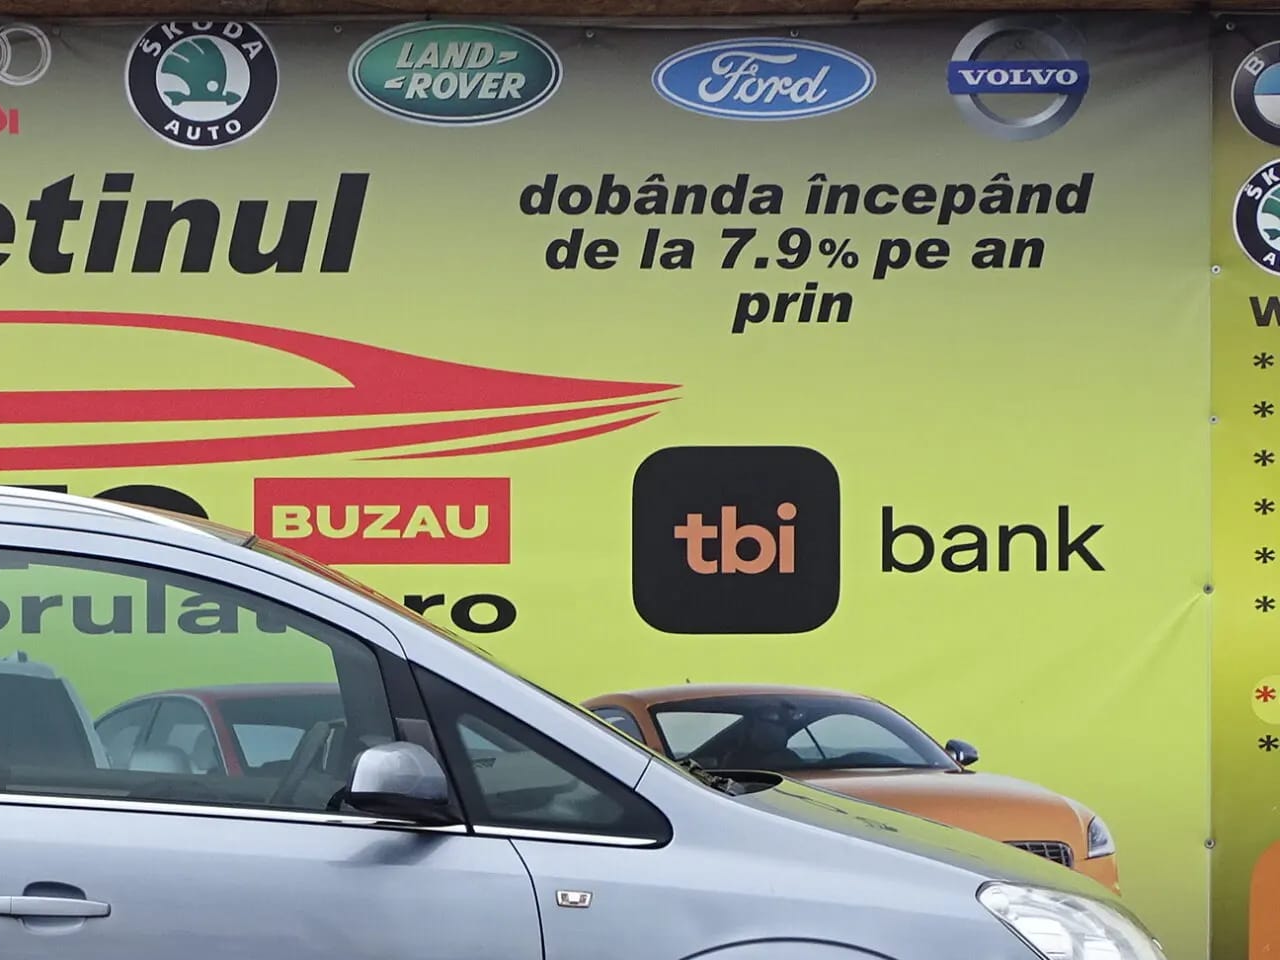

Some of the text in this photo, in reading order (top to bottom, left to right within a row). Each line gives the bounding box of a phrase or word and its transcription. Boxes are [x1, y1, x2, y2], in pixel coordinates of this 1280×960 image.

[396, 41, 496, 70] LAND
[405, 71, 527, 100] ROVER
[698, 51, 831, 104] Ford
[958, 69, 1079, 87] VOLVO
[164, 119, 241, 140] AUTO
[519, 172, 1095, 226] dobânda începând
[545, 227, 1046, 280] de la 7.9% pe an
[731, 281, 854, 334] prin
[271, 505, 490, 539] BUZAU
[673, 501, 1106, 575] tbi bank
